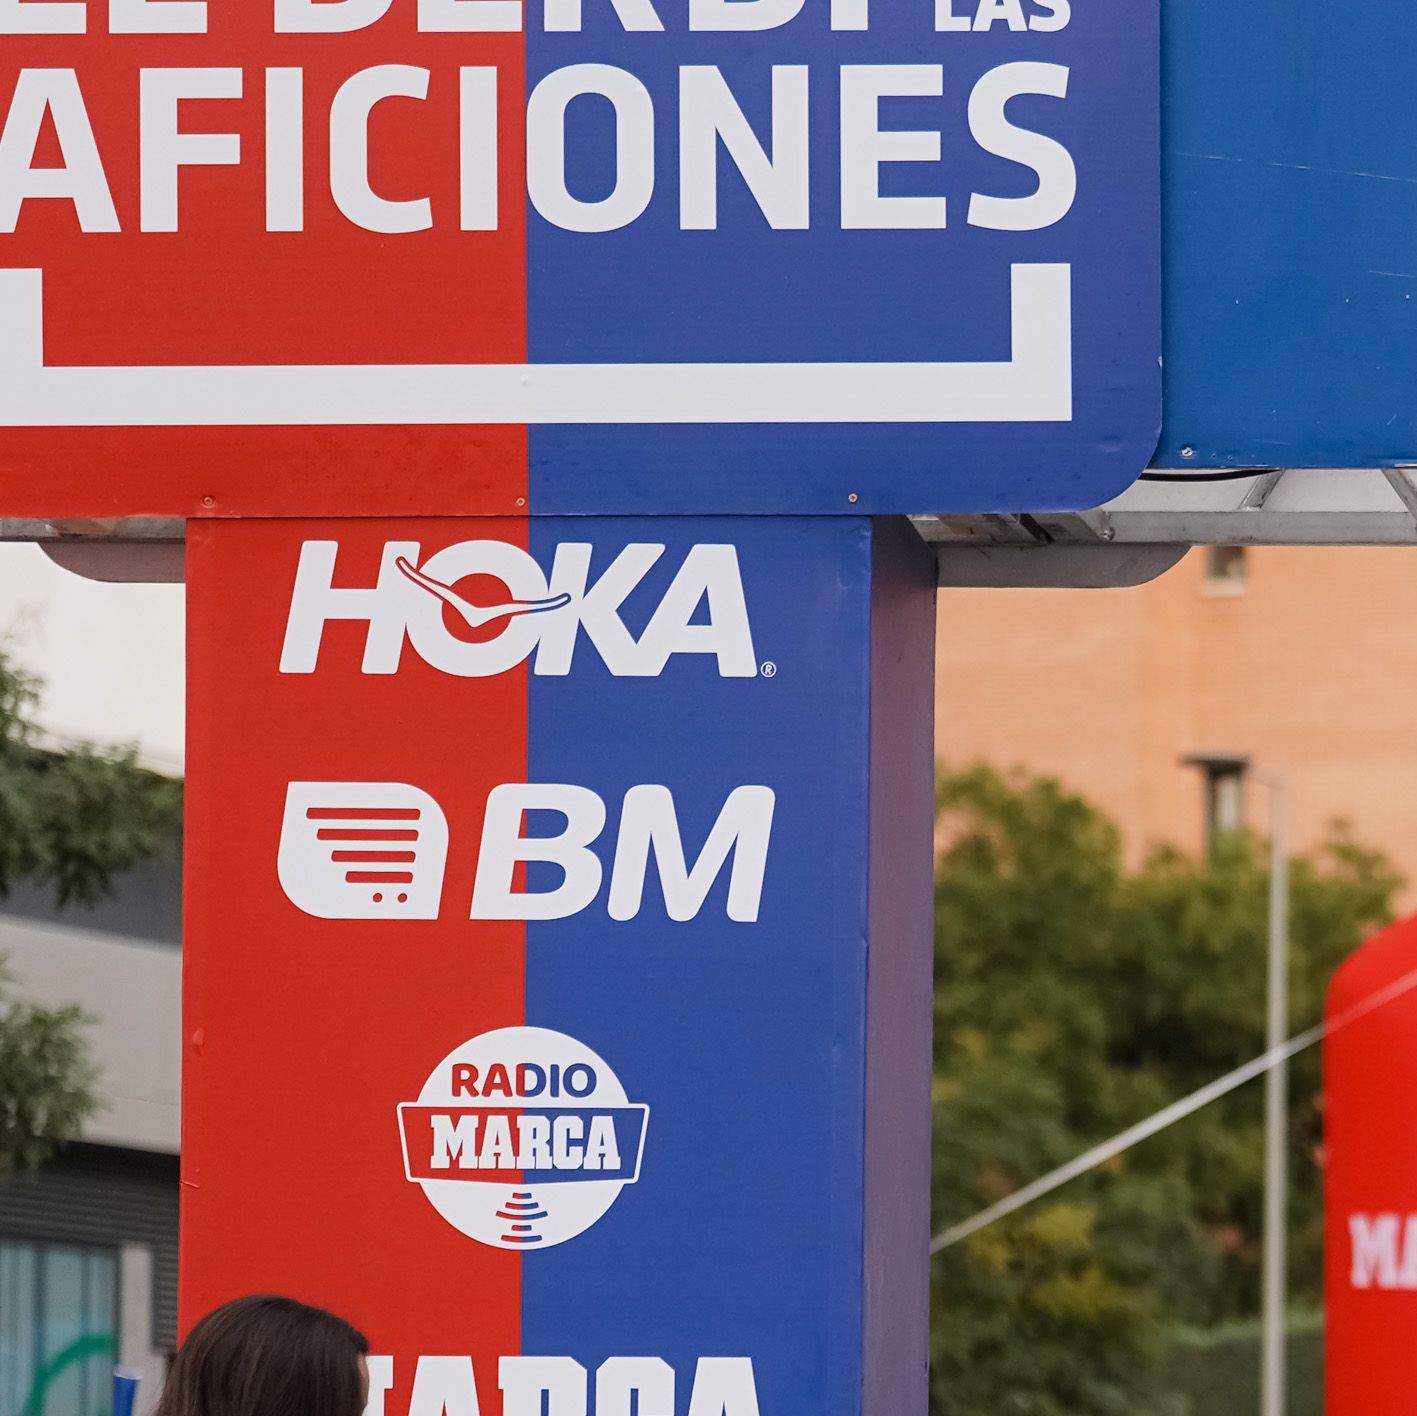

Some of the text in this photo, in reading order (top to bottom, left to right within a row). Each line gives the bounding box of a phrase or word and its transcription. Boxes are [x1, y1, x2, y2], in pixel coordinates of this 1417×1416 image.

[0, 64, 1078, 234] AFICIONES
[469, 783, 776, 923] BM
[451, 1062, 597, 1098] RADIO
[430, 1114, 621, 1170] MARCA
